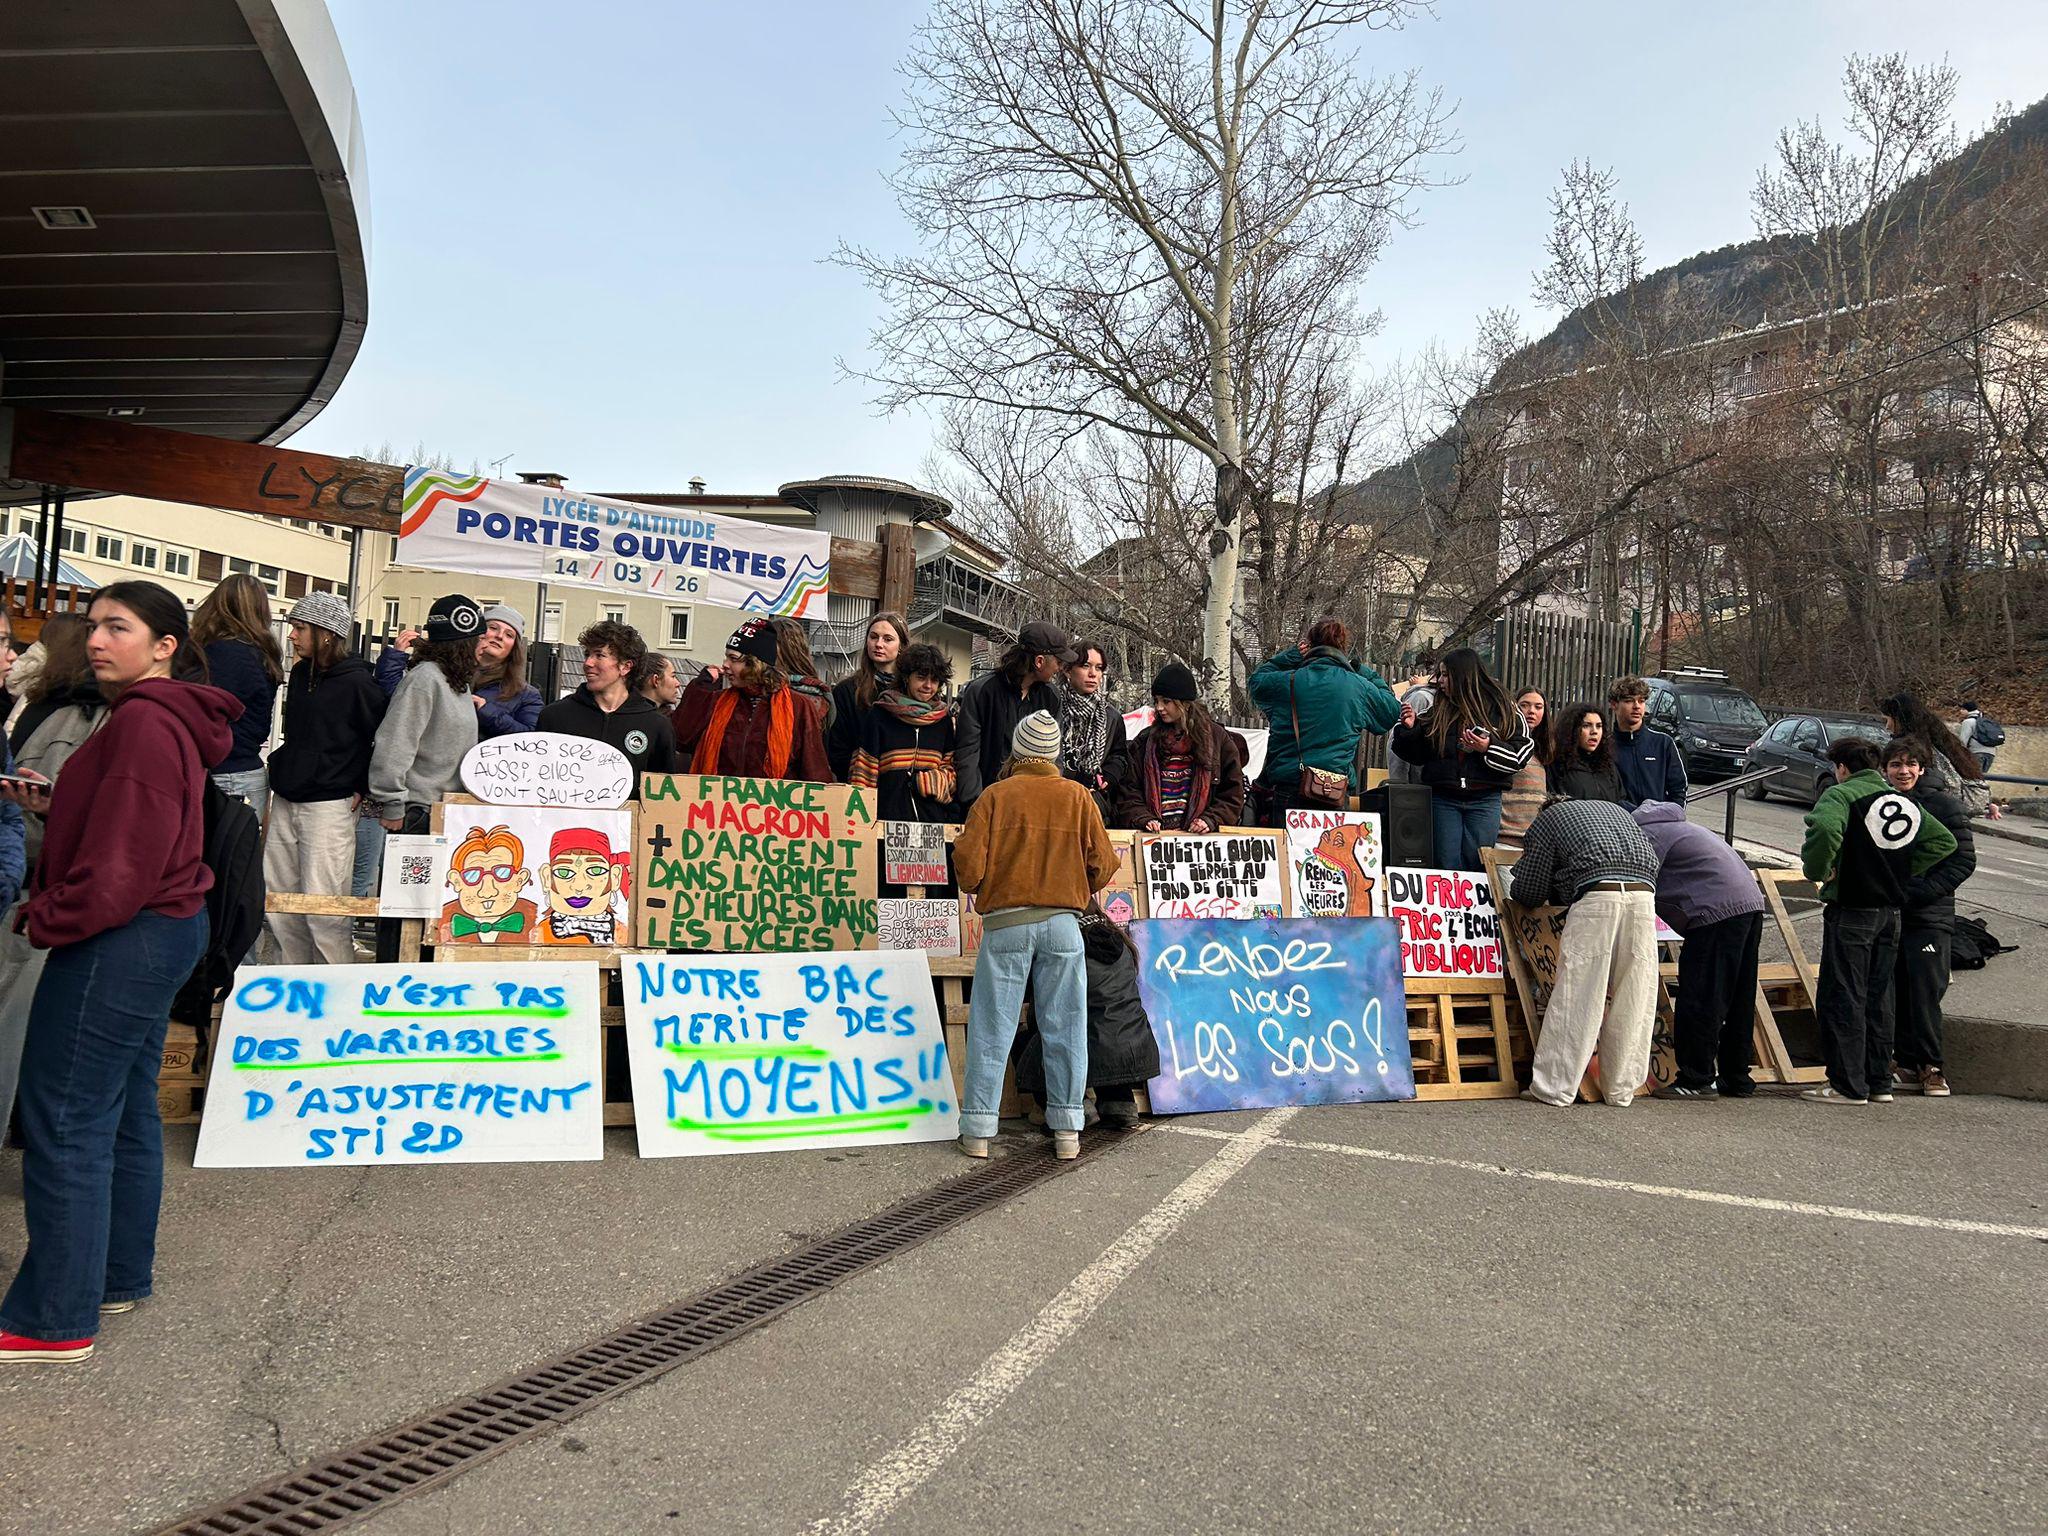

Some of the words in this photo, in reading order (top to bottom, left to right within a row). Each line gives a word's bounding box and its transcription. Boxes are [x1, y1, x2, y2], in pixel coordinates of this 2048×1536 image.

[542, 496, 598, 524] LYCÉE
[606, 507, 716, 541] D'ALTITUDE
[456, 507, 600, 552] PORTES
[613, 532, 787, 580] OUVERTES
[554, 558, 579, 576] 14
[614, 561, 642, 583] 03
[675, 575, 699, 593] 26
[480, 745, 509, 759] ET
[514, 740, 549, 756] NOS
[483, 783, 531, 799] VONT
[645, 775, 681, 802] LA
[699, 776, 825, 811] FRANCE
[687, 800, 830, 839] MACRON
[1879, 801, 1913, 842] 8
[681, 828, 863, 869] D'ARGENT
[1227, 837, 1276, 862] QU'ON
[648, 856, 727, 892] DANS
[887, 863, 947, 883] L'IGNORANCE
[1150, 864, 1176, 881] EST
[1243, 862, 1266, 879] AU
[1305, 862, 1343, 885] RENDEZ
[1310, 881, 1325, 890] LES
[1152, 881, 1190, 900] FOND
[1194, 881, 1210, 894] DE
[1216, 879, 1258, 898] CETTE
[1306, 892, 1345, 910] HEURES
[1390, 872, 1423, 904] DU
[672, 889, 817, 925] D'HEURES
[821, 896, 879, 935] DANS
[879, 900, 958, 920] SUPPRIMER
[648, 917, 712, 948] LES
[879, 925, 949, 943] SUPPRIMER
[236, 977, 326, 1018] ON
[362, 974, 471, 1007] N'EST
[494, 982, 566, 1009] PAS
[637, 962, 761, 1003] NOTRE
[798, 964, 889, 1004] BAC
[836, 1005, 915, 1038] DES
[232, 1034, 301, 1063] DES
[243, 1080, 592, 1121] D'AJUSTEMENT
